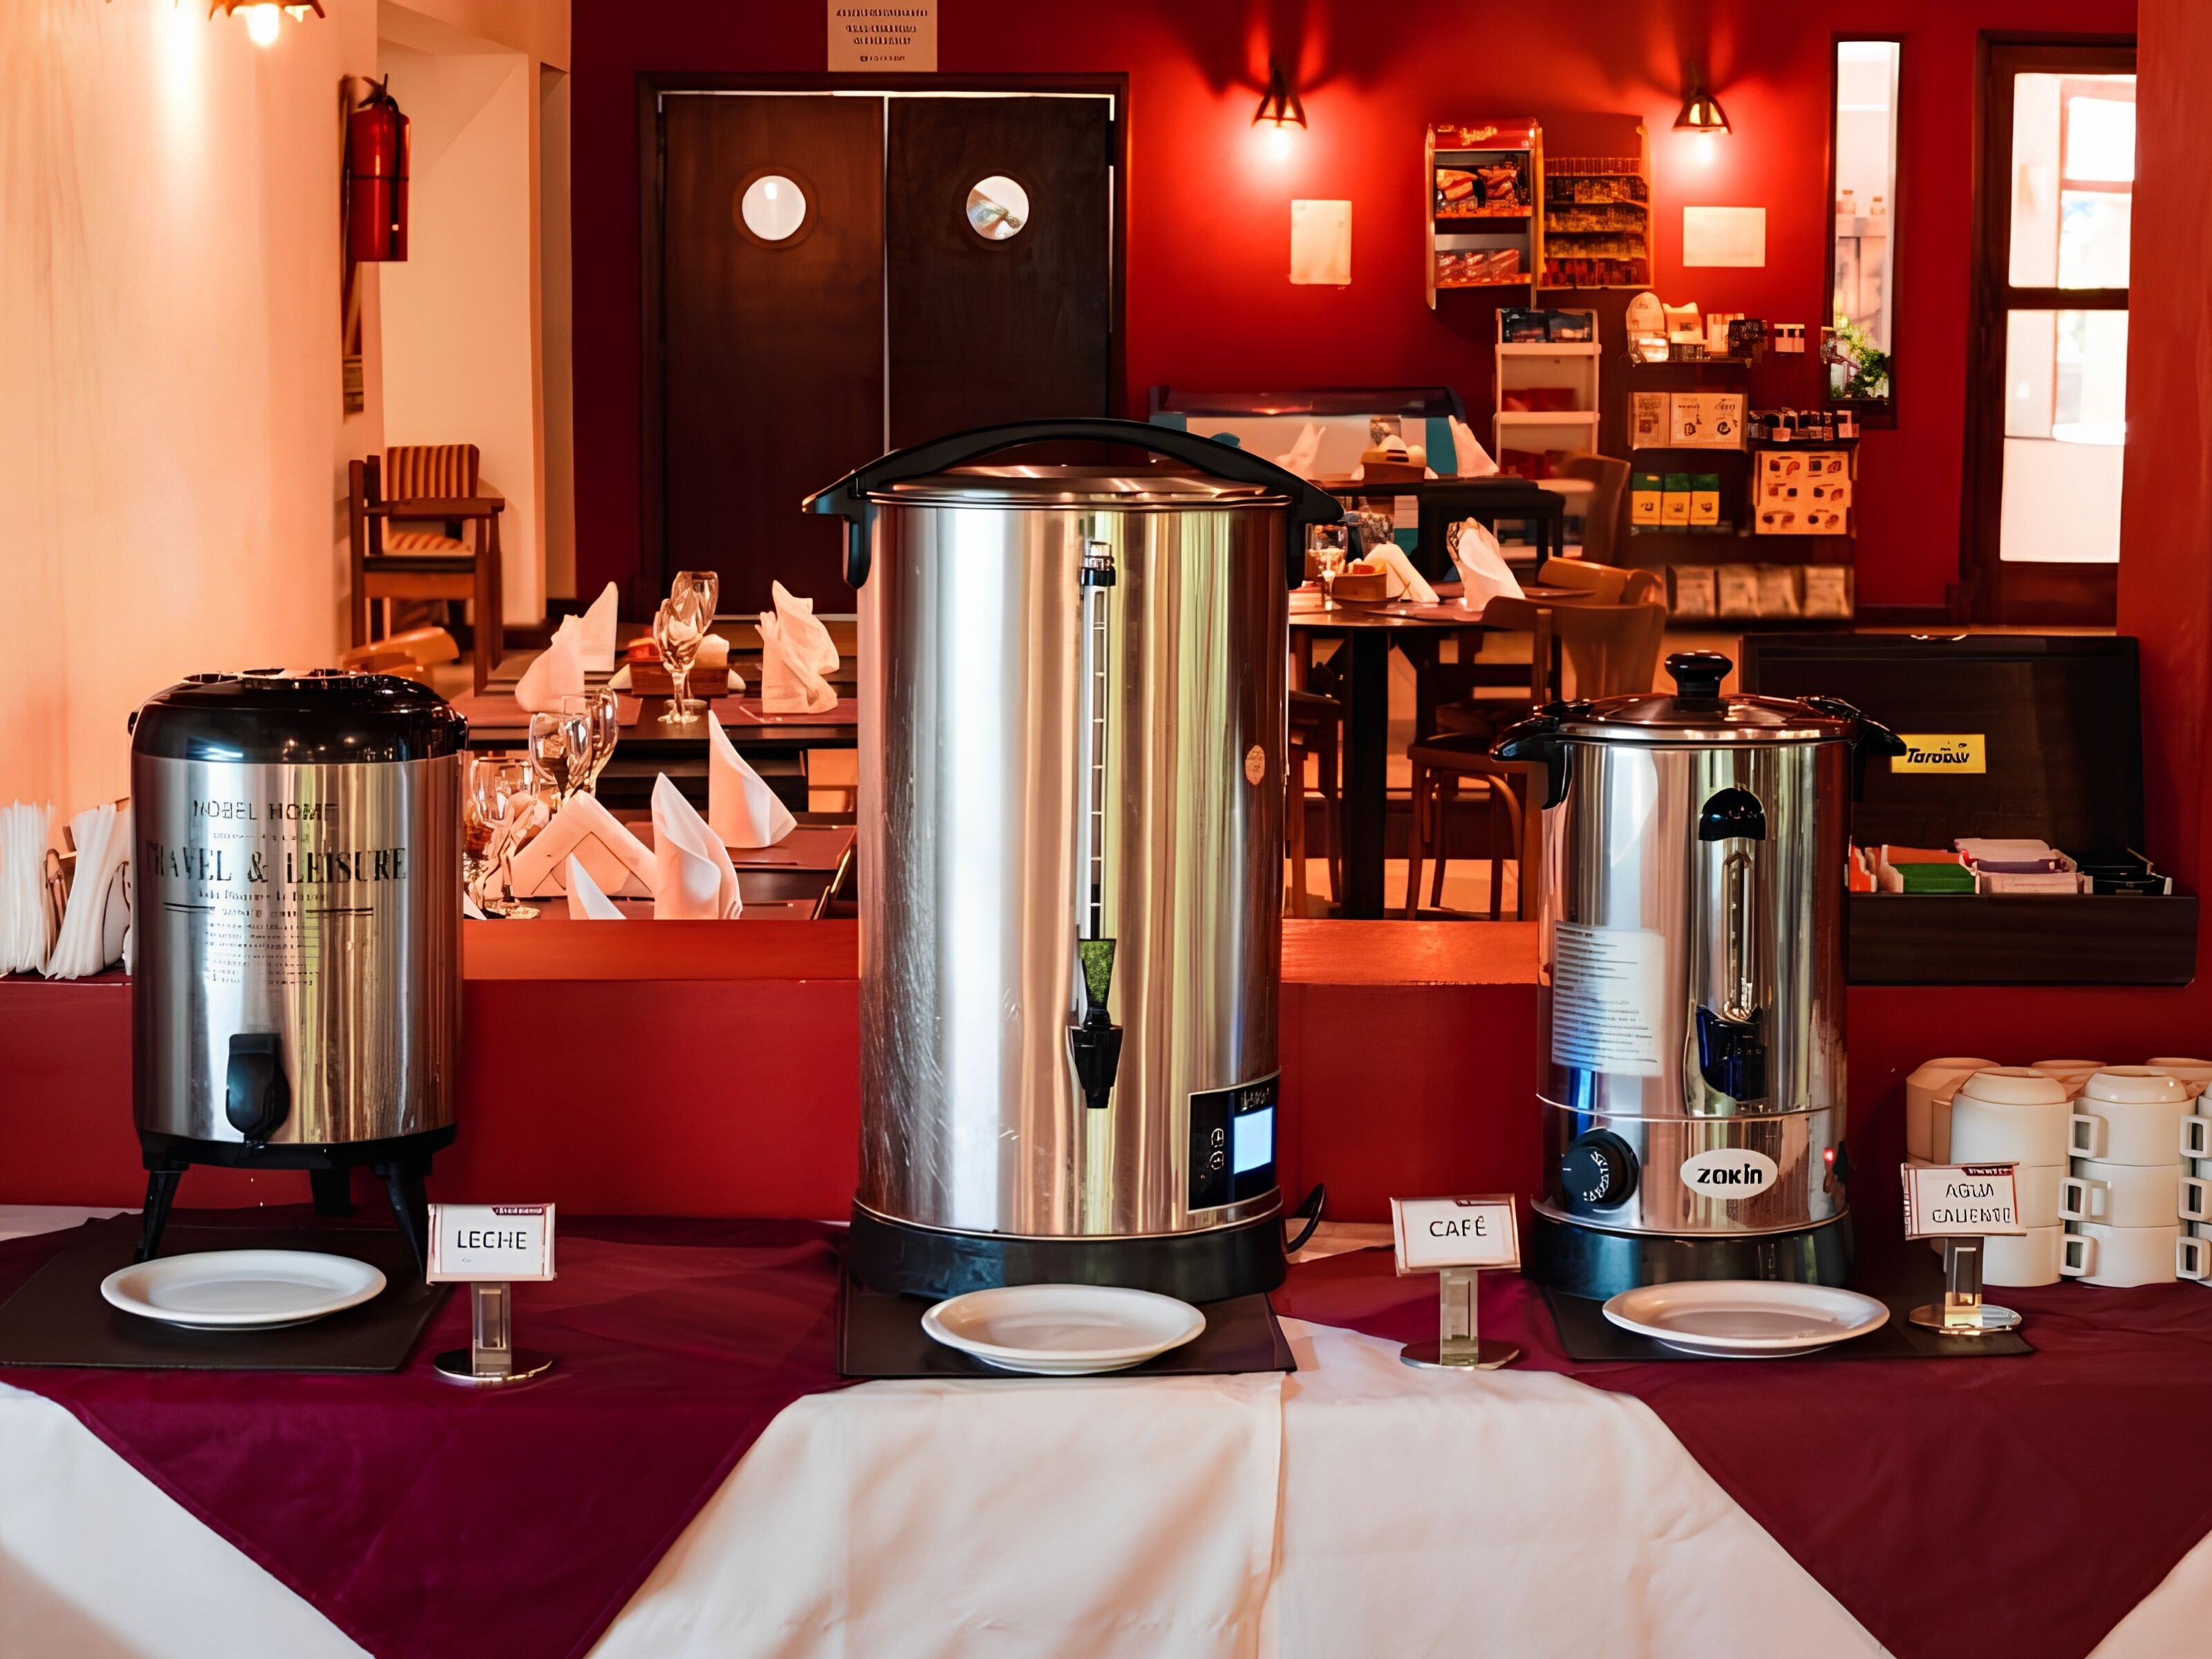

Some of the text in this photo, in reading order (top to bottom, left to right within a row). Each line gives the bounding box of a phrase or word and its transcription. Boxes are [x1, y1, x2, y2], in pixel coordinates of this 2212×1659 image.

[247, 851, 269, 883] &
[287, 847, 406, 883] LEISURE
[1945, 1183, 1995, 1199] AGUA
[457, 1230, 527, 1250] LECHE
